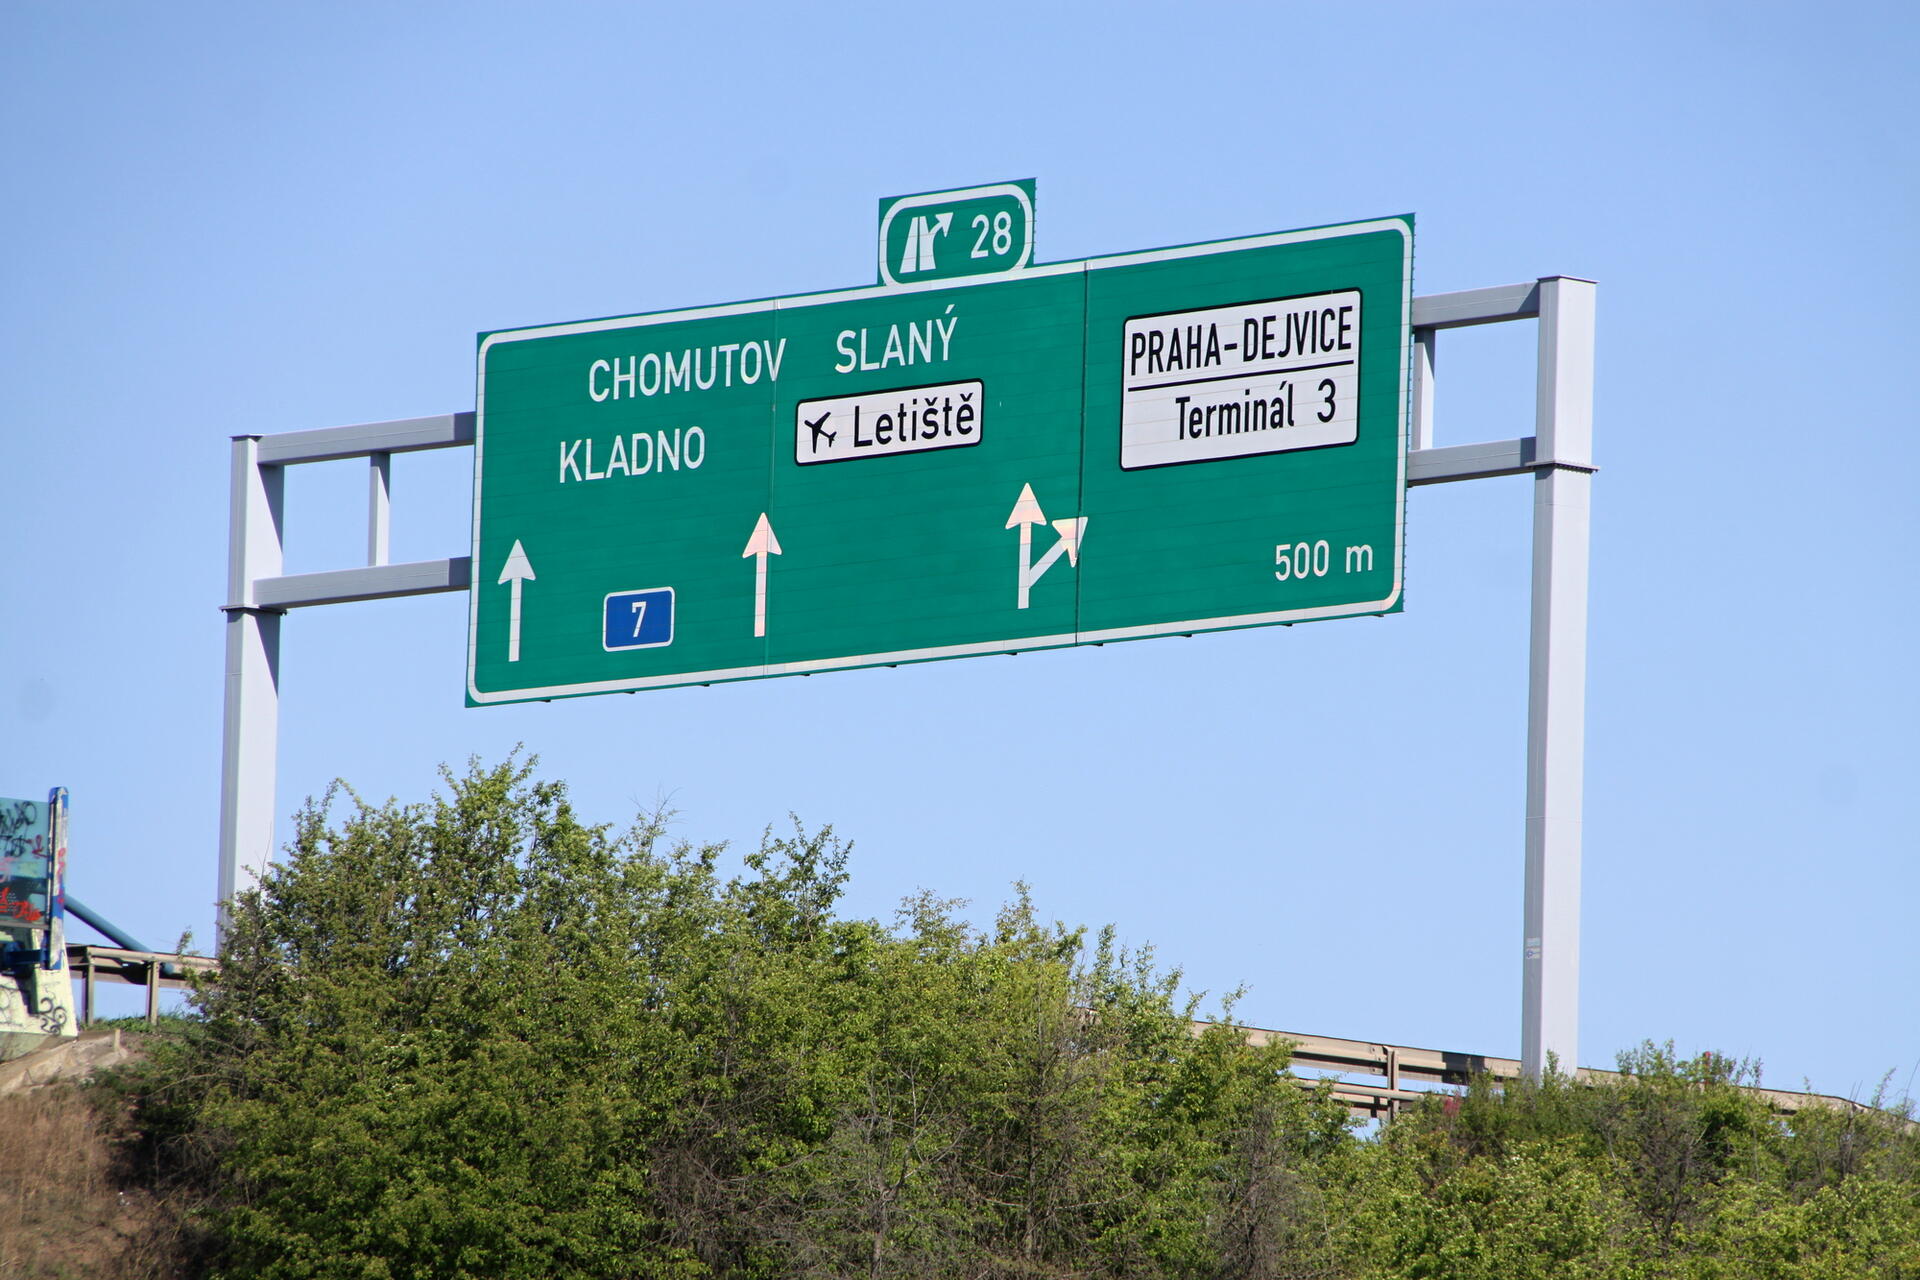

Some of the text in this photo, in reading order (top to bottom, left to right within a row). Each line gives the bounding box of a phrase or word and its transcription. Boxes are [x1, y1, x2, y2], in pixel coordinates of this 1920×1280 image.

[971, 210, 1012, 258] 28
[835, 304, 958, 374] SLANÝ
[1131, 305, 1353, 376] PRAHA-DEJVICE
[588, 338, 787, 403] CHOMUTOV
[853, 392, 975, 448] Letiště
[1176, 378, 1337, 440] Terminál 3
[559, 426, 706, 483] KLADNO
[1275, 540, 1374, 581] 500 m
[631, 601, 647, 638] 7
